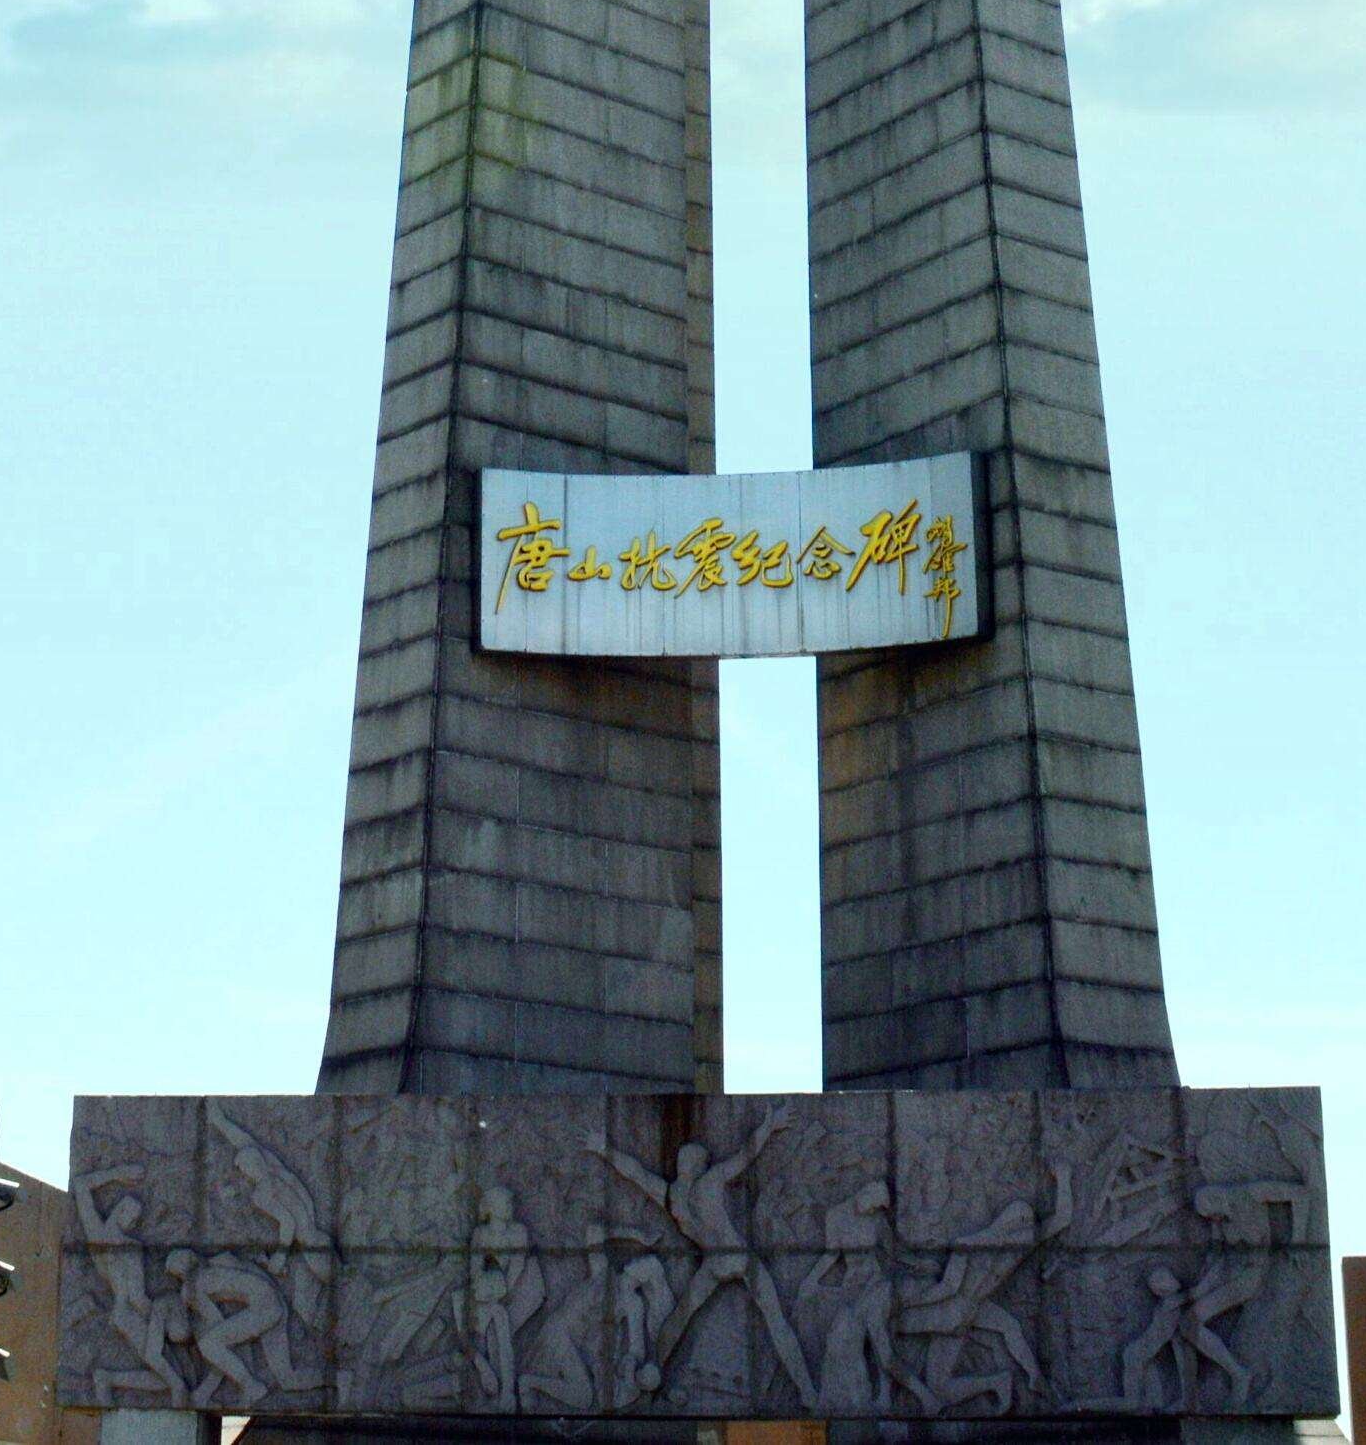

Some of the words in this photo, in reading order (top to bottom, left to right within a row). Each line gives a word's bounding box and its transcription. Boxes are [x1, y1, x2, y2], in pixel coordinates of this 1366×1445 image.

[495, 498, 922, 614] 唐山抗震纪念碑
